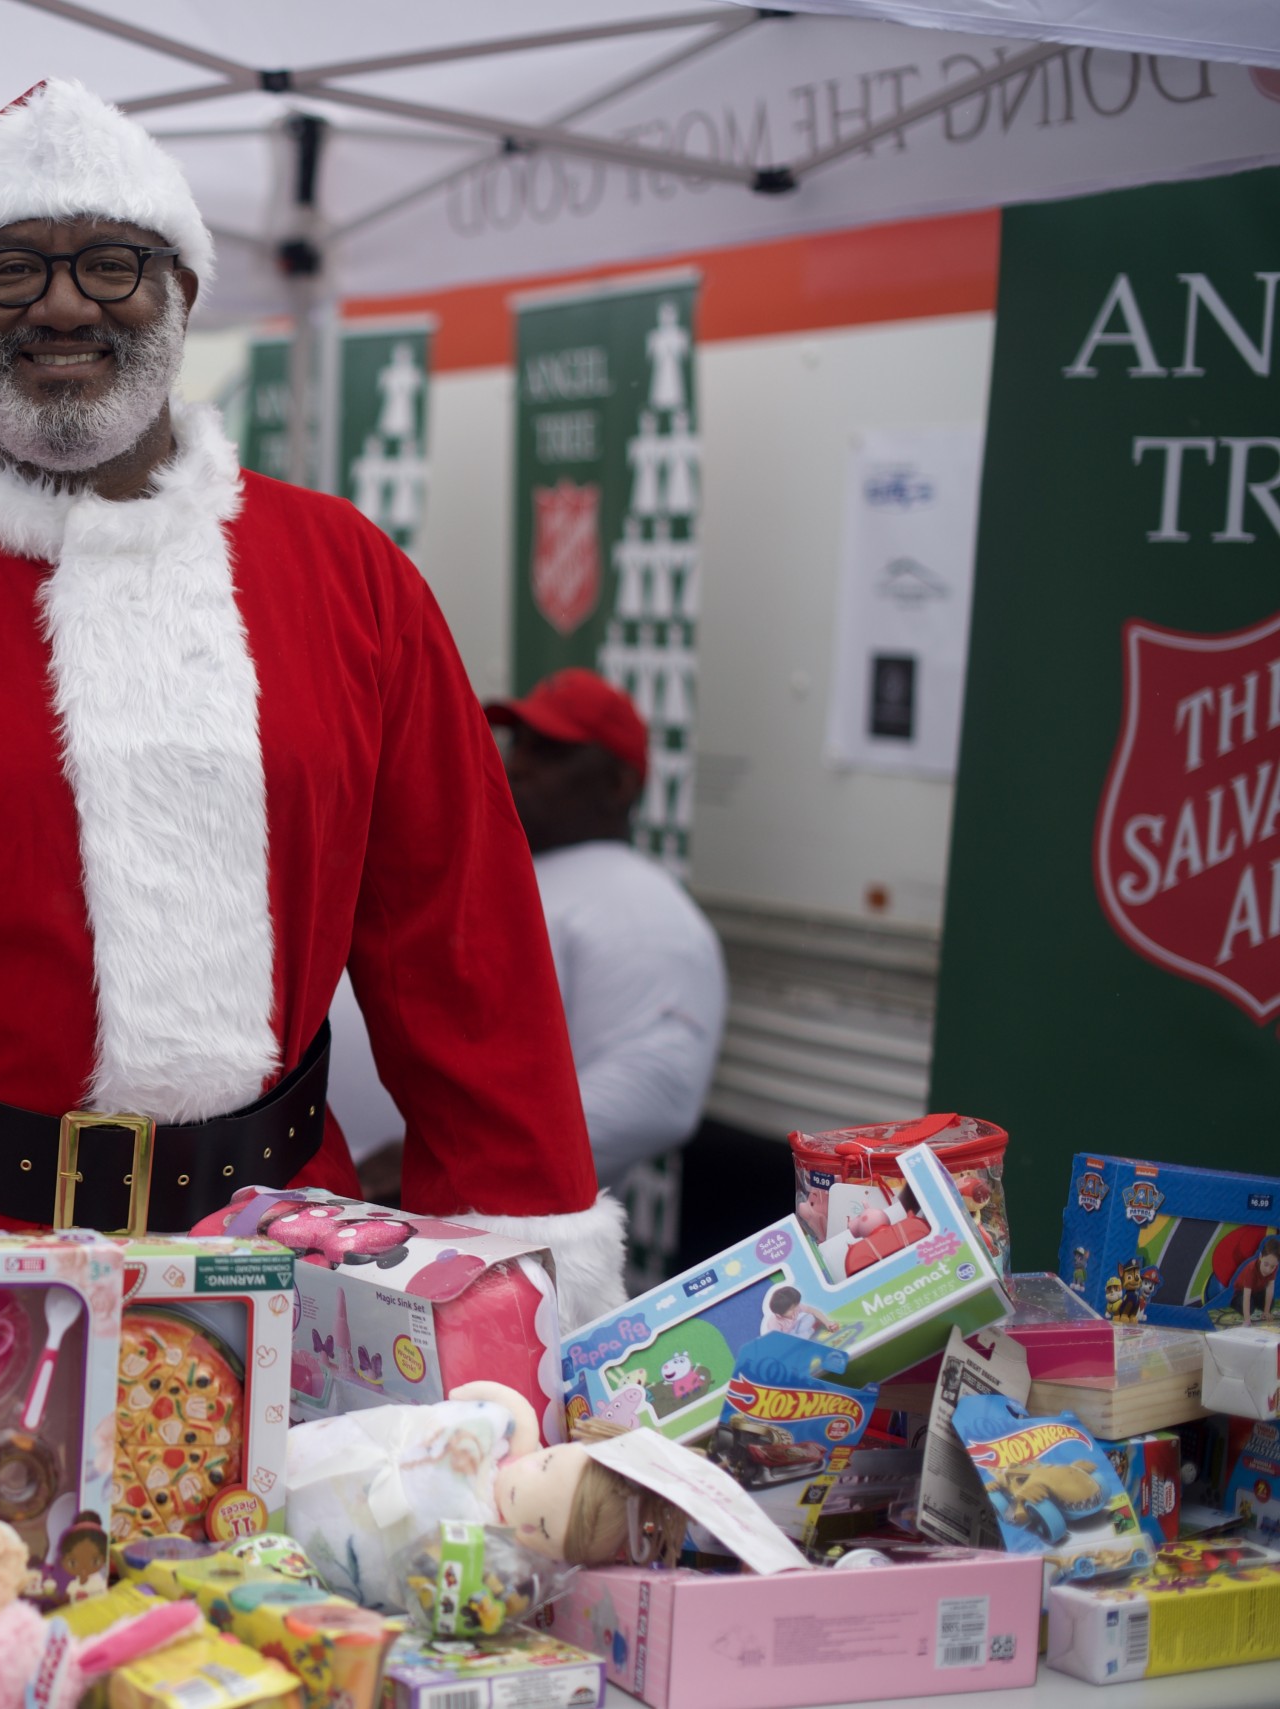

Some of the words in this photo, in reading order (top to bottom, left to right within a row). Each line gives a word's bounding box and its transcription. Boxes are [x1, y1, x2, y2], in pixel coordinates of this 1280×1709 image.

[375, 1291, 397, 1306] Magic
[397, 1297, 412, 1310] Sink
[413, 1302, 426, 1313] Set
[861, 1261, 951, 1316] Megamat
[569, 1335, 620, 1370] Peppa
[619, 1318, 652, 1345] Pig
[218, 1497, 259, 1517] Pieces
